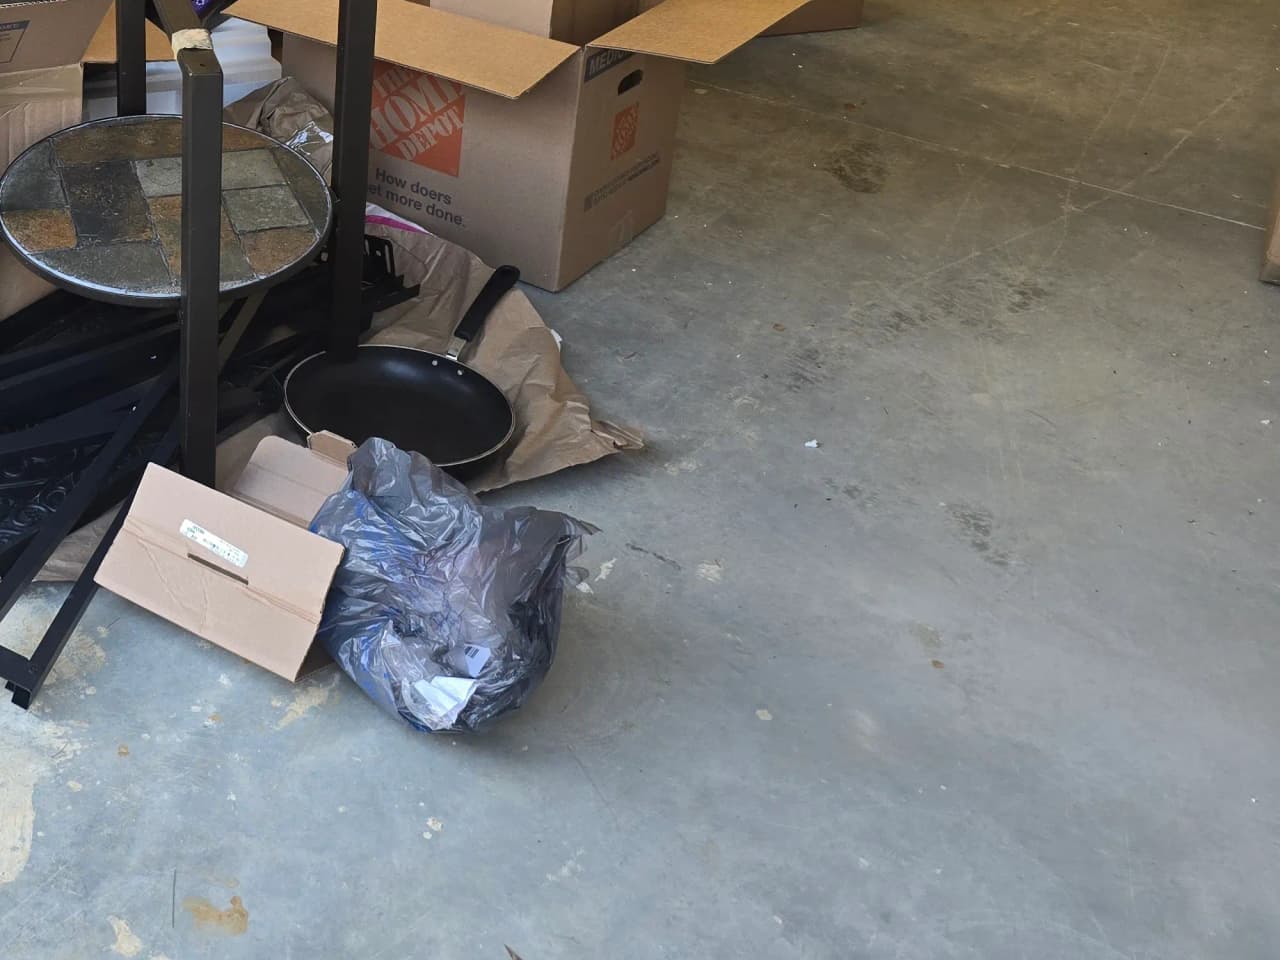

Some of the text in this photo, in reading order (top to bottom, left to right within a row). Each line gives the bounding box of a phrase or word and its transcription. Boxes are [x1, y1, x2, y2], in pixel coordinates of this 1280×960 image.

[397, 106, 464, 161] DEPOT
[375, 167, 452, 206] How doers
[386, 190, 423, 211] more
[426, 201, 466, 227] done.
